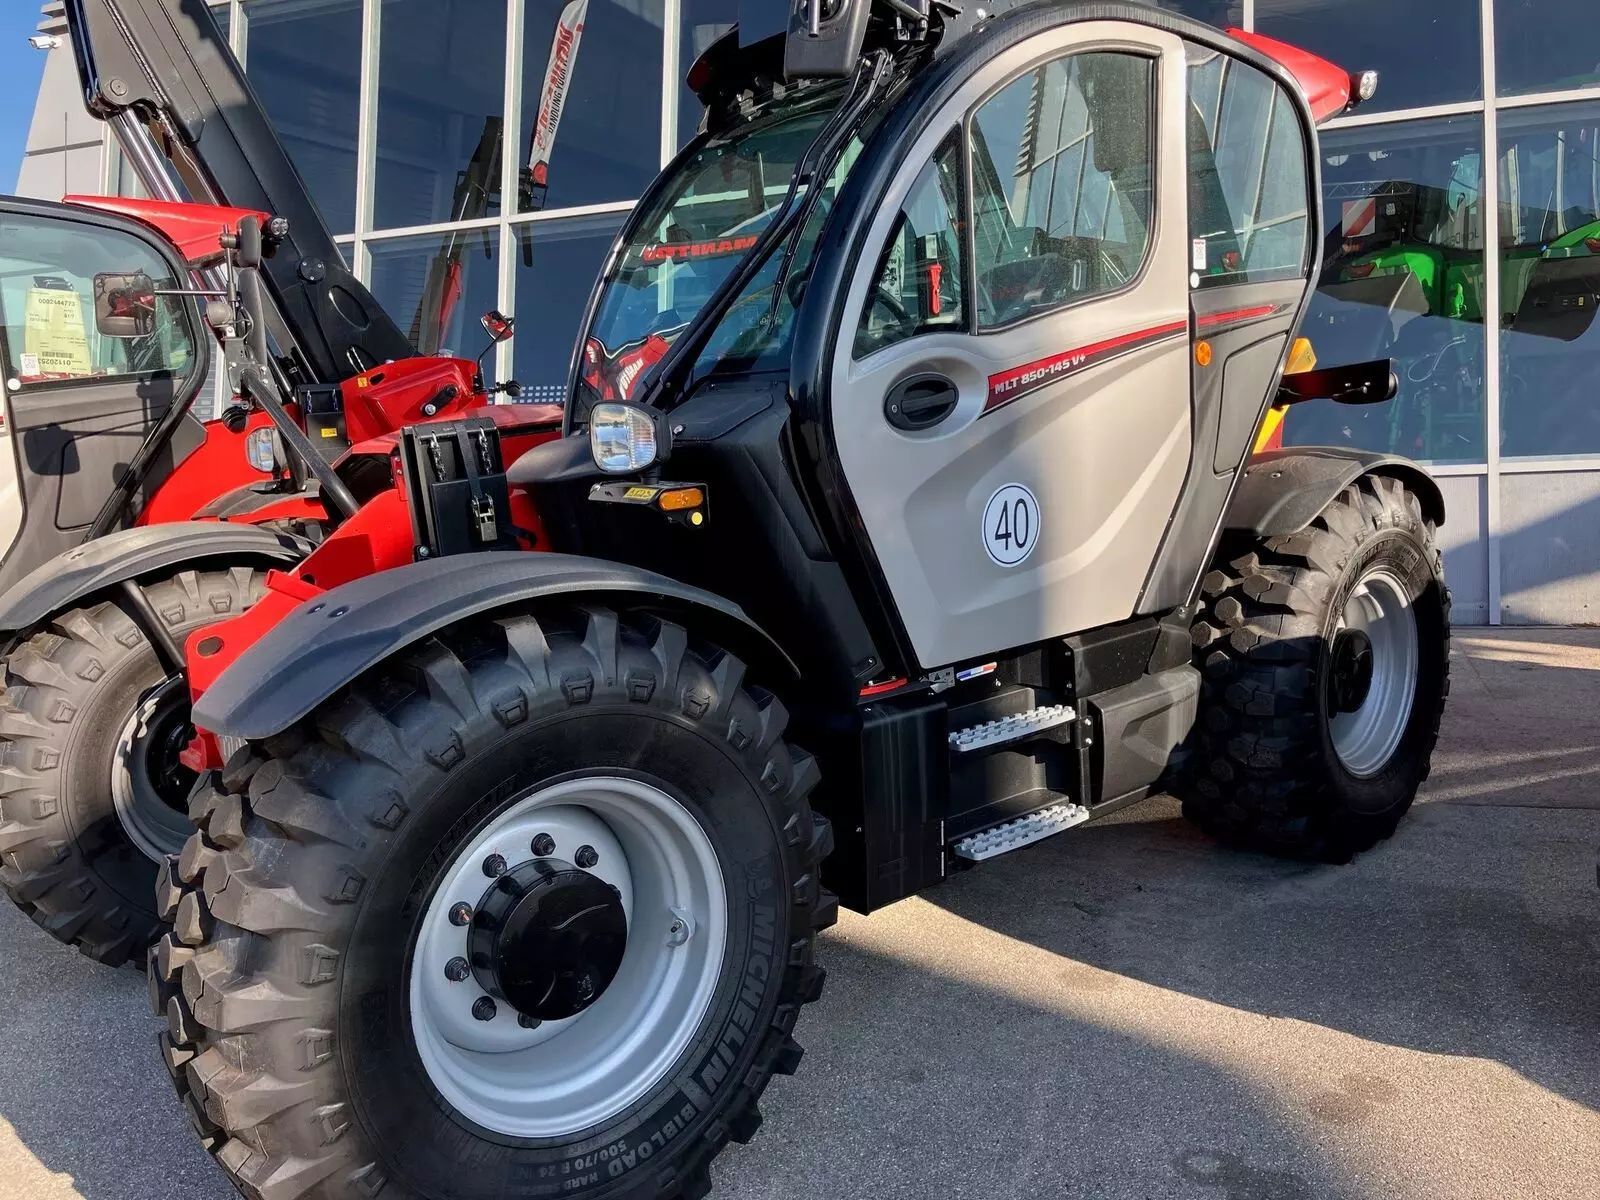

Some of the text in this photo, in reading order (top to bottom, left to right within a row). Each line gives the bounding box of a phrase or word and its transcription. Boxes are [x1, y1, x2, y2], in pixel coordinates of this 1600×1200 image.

[995, 353, 1086, 395] MLT 850-145 V+
[994, 498, 1029, 551] 40
[700, 904, 776, 1096] MICHELIN
[574, 1140, 627, 1171] 500/70
[607, 1102, 697, 1178] BIBLOAD
[563, 1172, 600, 1191] HARD
